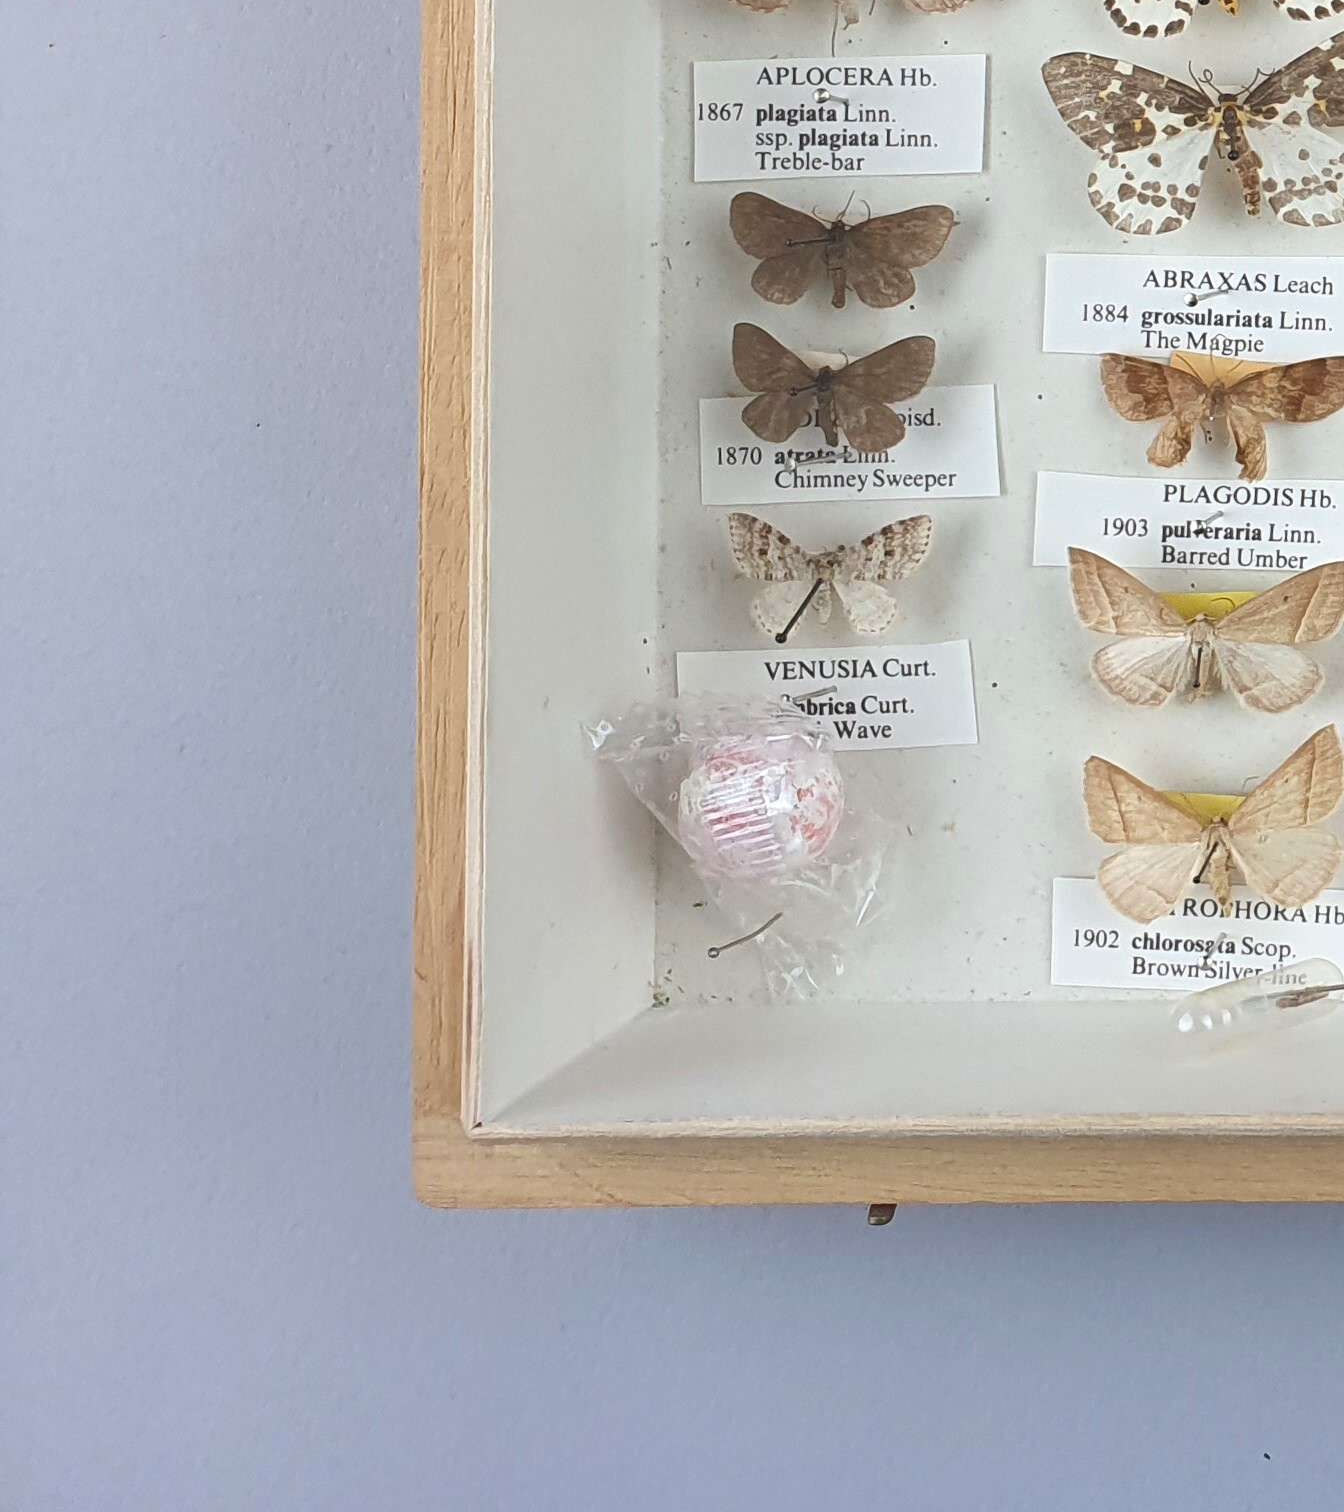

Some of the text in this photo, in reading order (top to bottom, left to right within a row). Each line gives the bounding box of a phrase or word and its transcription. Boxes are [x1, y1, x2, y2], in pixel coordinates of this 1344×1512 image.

[756, 66, 937, 87] APLOCERA Hb.
[698, 102, 896, 127] 1867 plagiata Linn.
[755, 128, 938, 151] ssp. plagiata Linn.
[755, 151, 865, 172] Treble-bar
[1143, 269, 1334, 295] ABRAXAS Leach
[1082, 303, 1333, 332] 1884 grossulariata Linn.
[1140, 330, 1264, 357] The Magpie
[717, 446, 762, 466] 1870
[774, 469, 957, 492] Chimney Sweeper
[1163, 484, 1337, 509] PLAGODIS Hb.
[1102, 517, 1148, 537] 1903
[1268, 523, 1321, 544] Linn.
[1161, 545, 1308, 569] Barred Umber
[764, 658, 936, 681] VENUSIA Curt.
[860, 694, 915, 715] Curt.
[833, 720, 893, 739] Wave
[1072, 928, 1120, 949] 1902
[1241, 936, 1296, 959] Scop.
[1132, 956, 1199, 978] Brown
